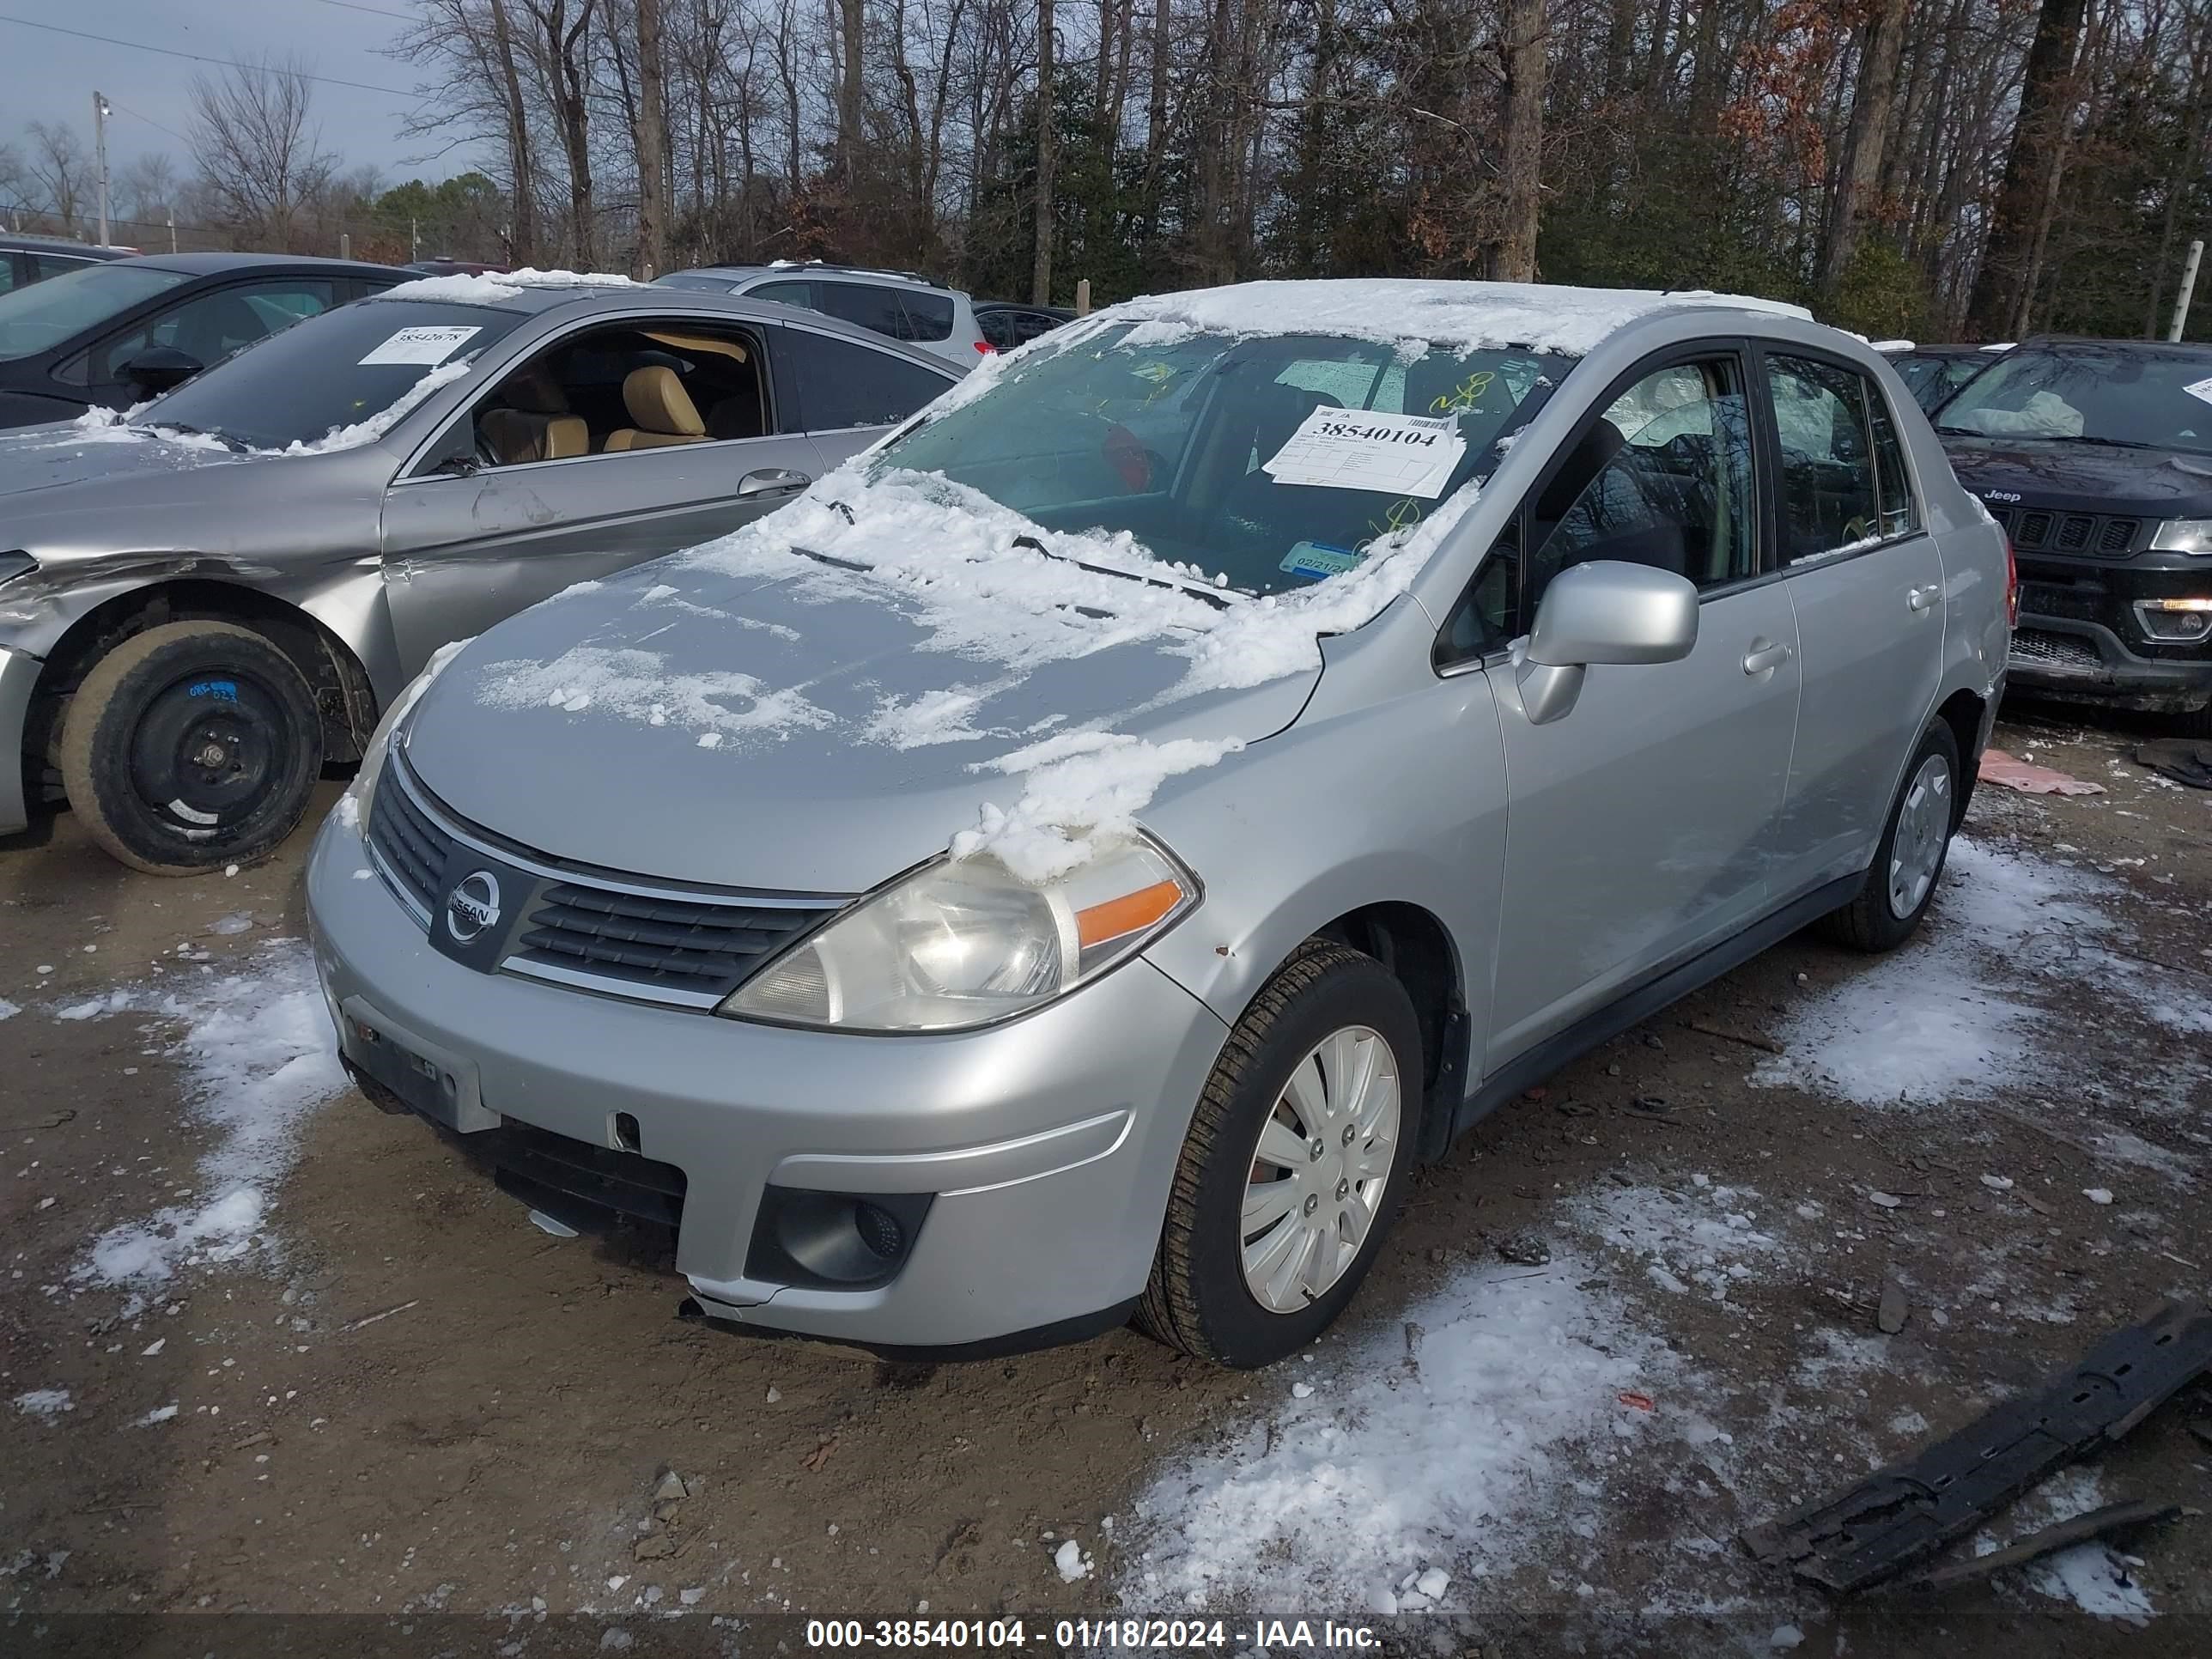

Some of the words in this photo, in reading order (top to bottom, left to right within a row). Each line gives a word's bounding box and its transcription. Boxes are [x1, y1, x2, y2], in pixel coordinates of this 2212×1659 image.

[1312, 422, 1438, 447] 38540104
[1984, 489, 2021, 502] Jeep
[449, 893, 489, 922] NISSAN
